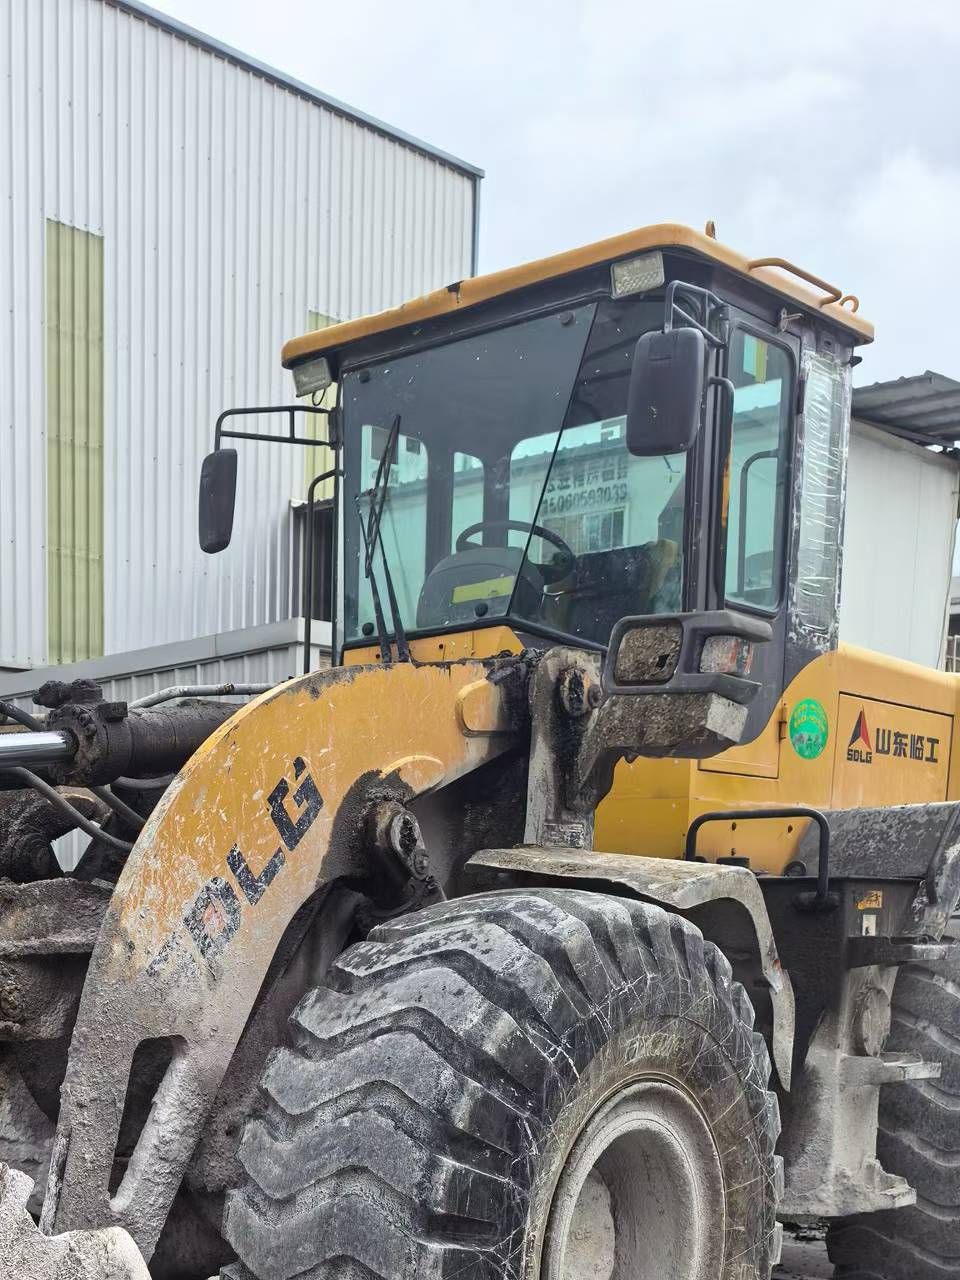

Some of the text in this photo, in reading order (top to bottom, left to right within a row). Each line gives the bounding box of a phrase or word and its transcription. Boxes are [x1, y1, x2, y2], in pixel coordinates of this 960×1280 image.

[846, 748, 872, 764] SDLG
[875, 727, 939, 763] 山东临工
